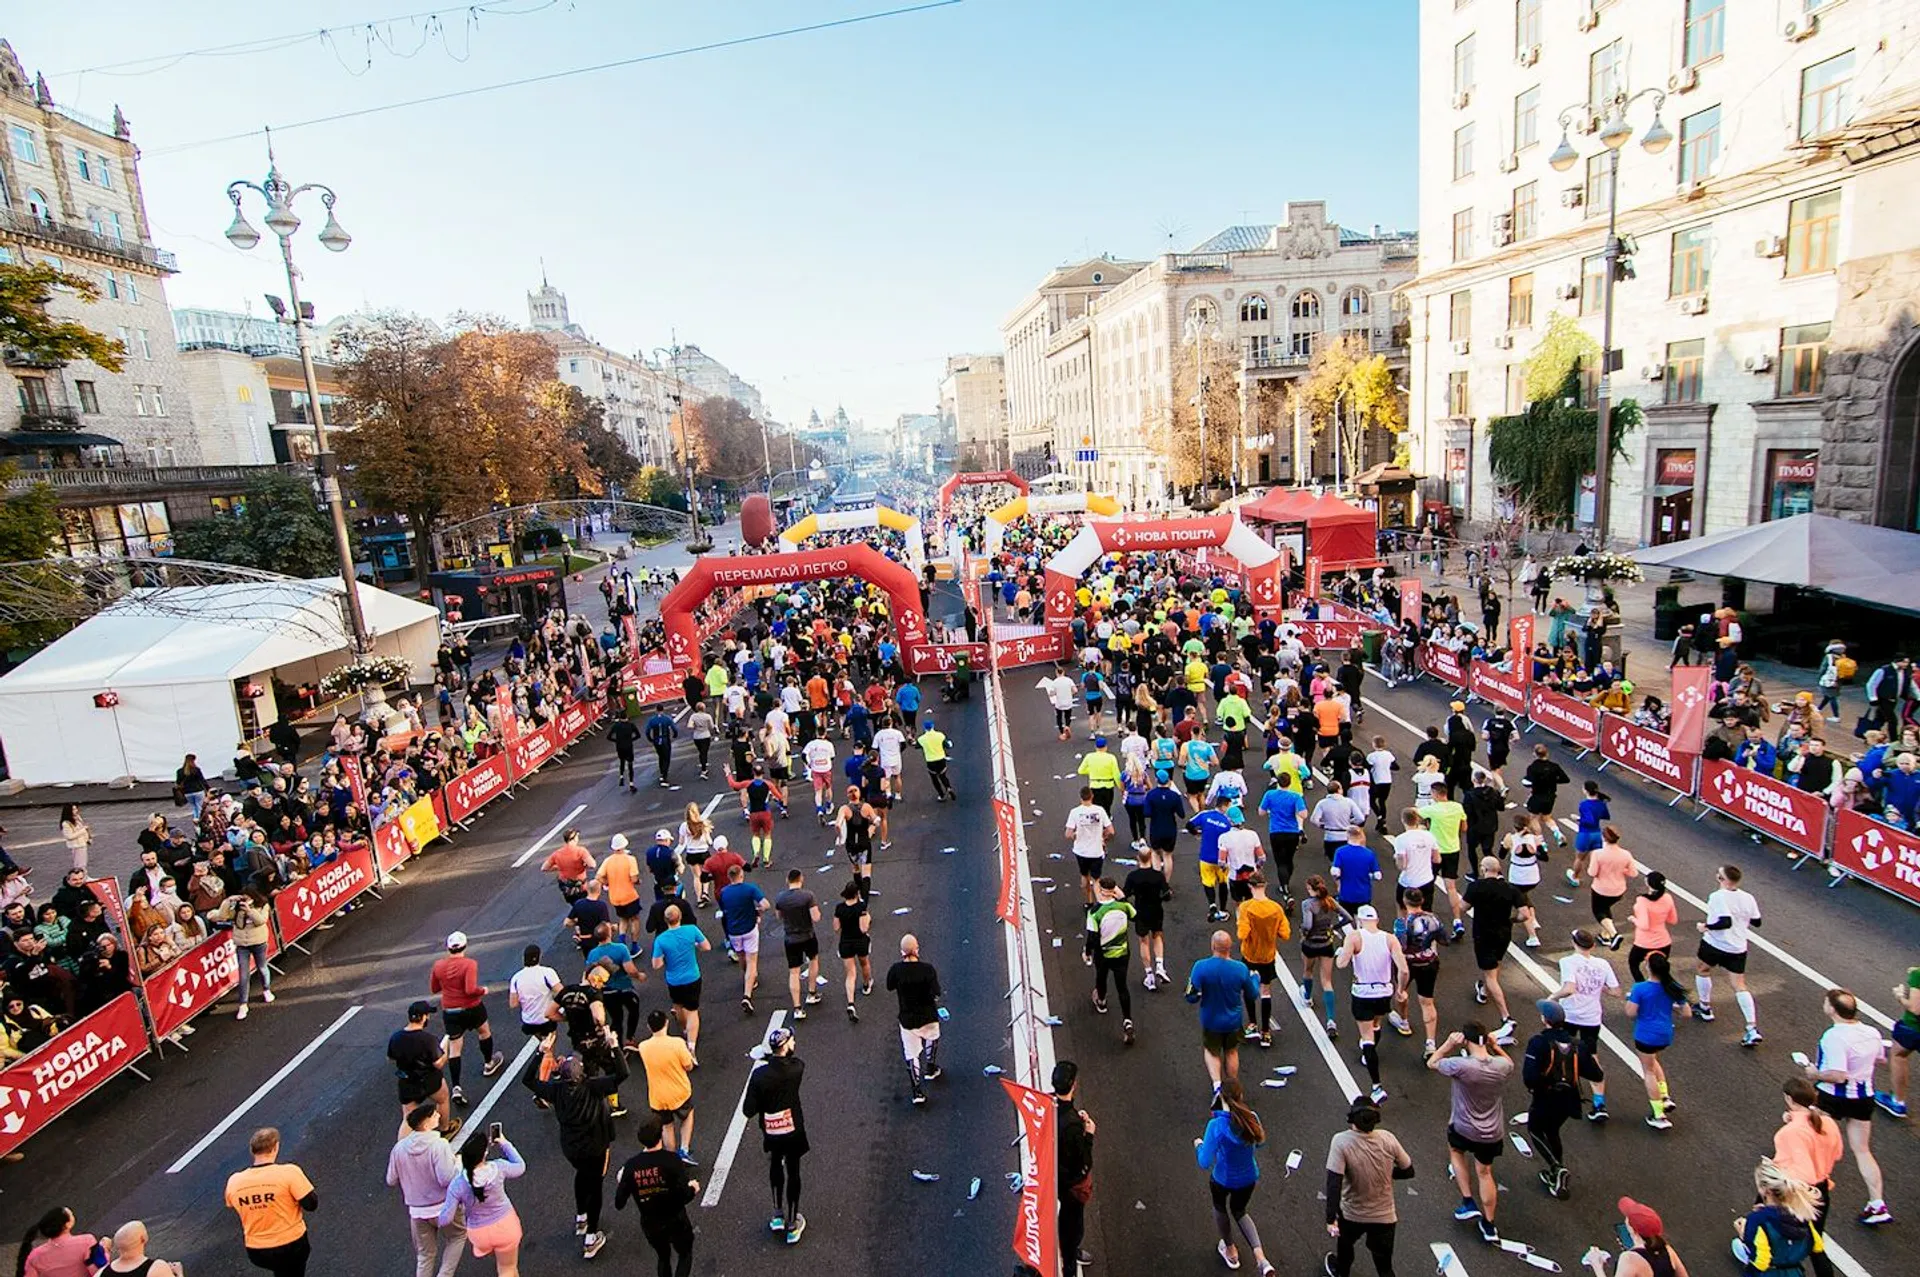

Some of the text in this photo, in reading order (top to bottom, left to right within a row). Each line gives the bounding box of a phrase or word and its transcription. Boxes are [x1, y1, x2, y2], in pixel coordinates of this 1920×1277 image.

[1134, 529, 1216, 542] НОВА ПОШТА
[713, 560, 848, 581] ПЕРЕМАГАЙ ЛЕГКО
[1314, 623, 1337, 646] RUN
[1017, 640, 1035, 662] RUN
[1545, 703, 1595, 734] НОВА ПОШТА
[1635, 735, 1671, 761] НОВА
[471, 767, 495, 787] НОВА
[1634, 749, 1681, 780] ПОШТА
[473, 773, 503, 799] ПОШТА
[1745, 781, 1793, 813] НОВА
[1744, 796, 1807, 836] ПОШТА
[316, 861, 352, 890] НОВА
[319, 867, 364, 905] ПОШТА
[1006, 829, 1015, 917] НОВА ПОШТА
[200, 938, 237, 970] НОВ
[32, 1031, 103, 1085] НОВА
[37, 1035, 128, 1104] ПОШТА
[634, 1167, 659, 1179] NIKE
[238, 1193, 276, 1206] NBR
[1024, 1193, 1041, 1266] ПОШТА
